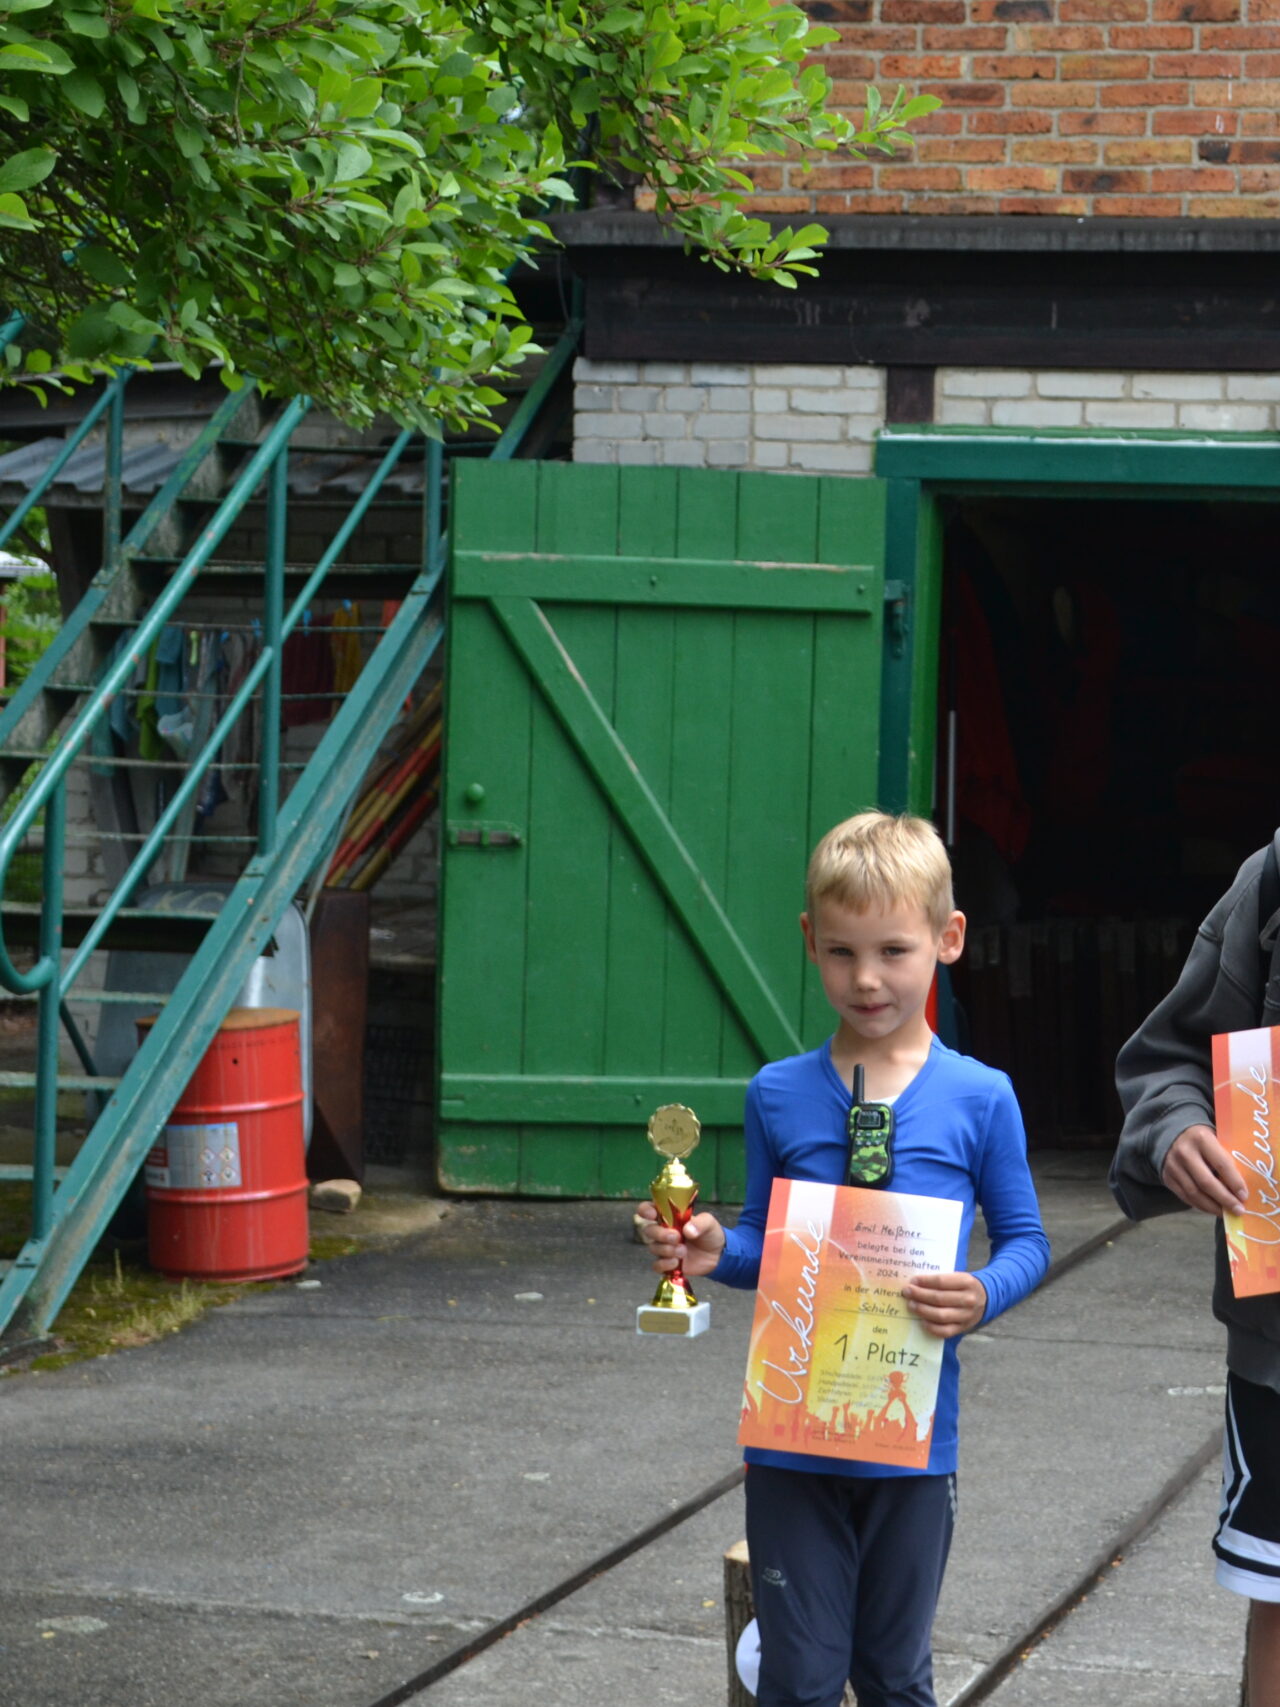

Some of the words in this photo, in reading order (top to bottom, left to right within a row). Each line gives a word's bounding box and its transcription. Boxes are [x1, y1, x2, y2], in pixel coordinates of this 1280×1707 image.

[857, 1241, 889, 1252] belegte
[893, 1245, 906, 1254] bei
[909, 1248, 925, 1257] den
[838, 1250, 940, 1270] Vereinsmeisterschaften
[877, 1270, 899, 1278] 2024
[844, 1284, 852, 1292] in
[855, 1285, 869, 1294] der
[757, 1218, 824, 1405] Urkunde
[872, 1326, 888, 1335] den
[866, 1341, 921, 1368] Platz
